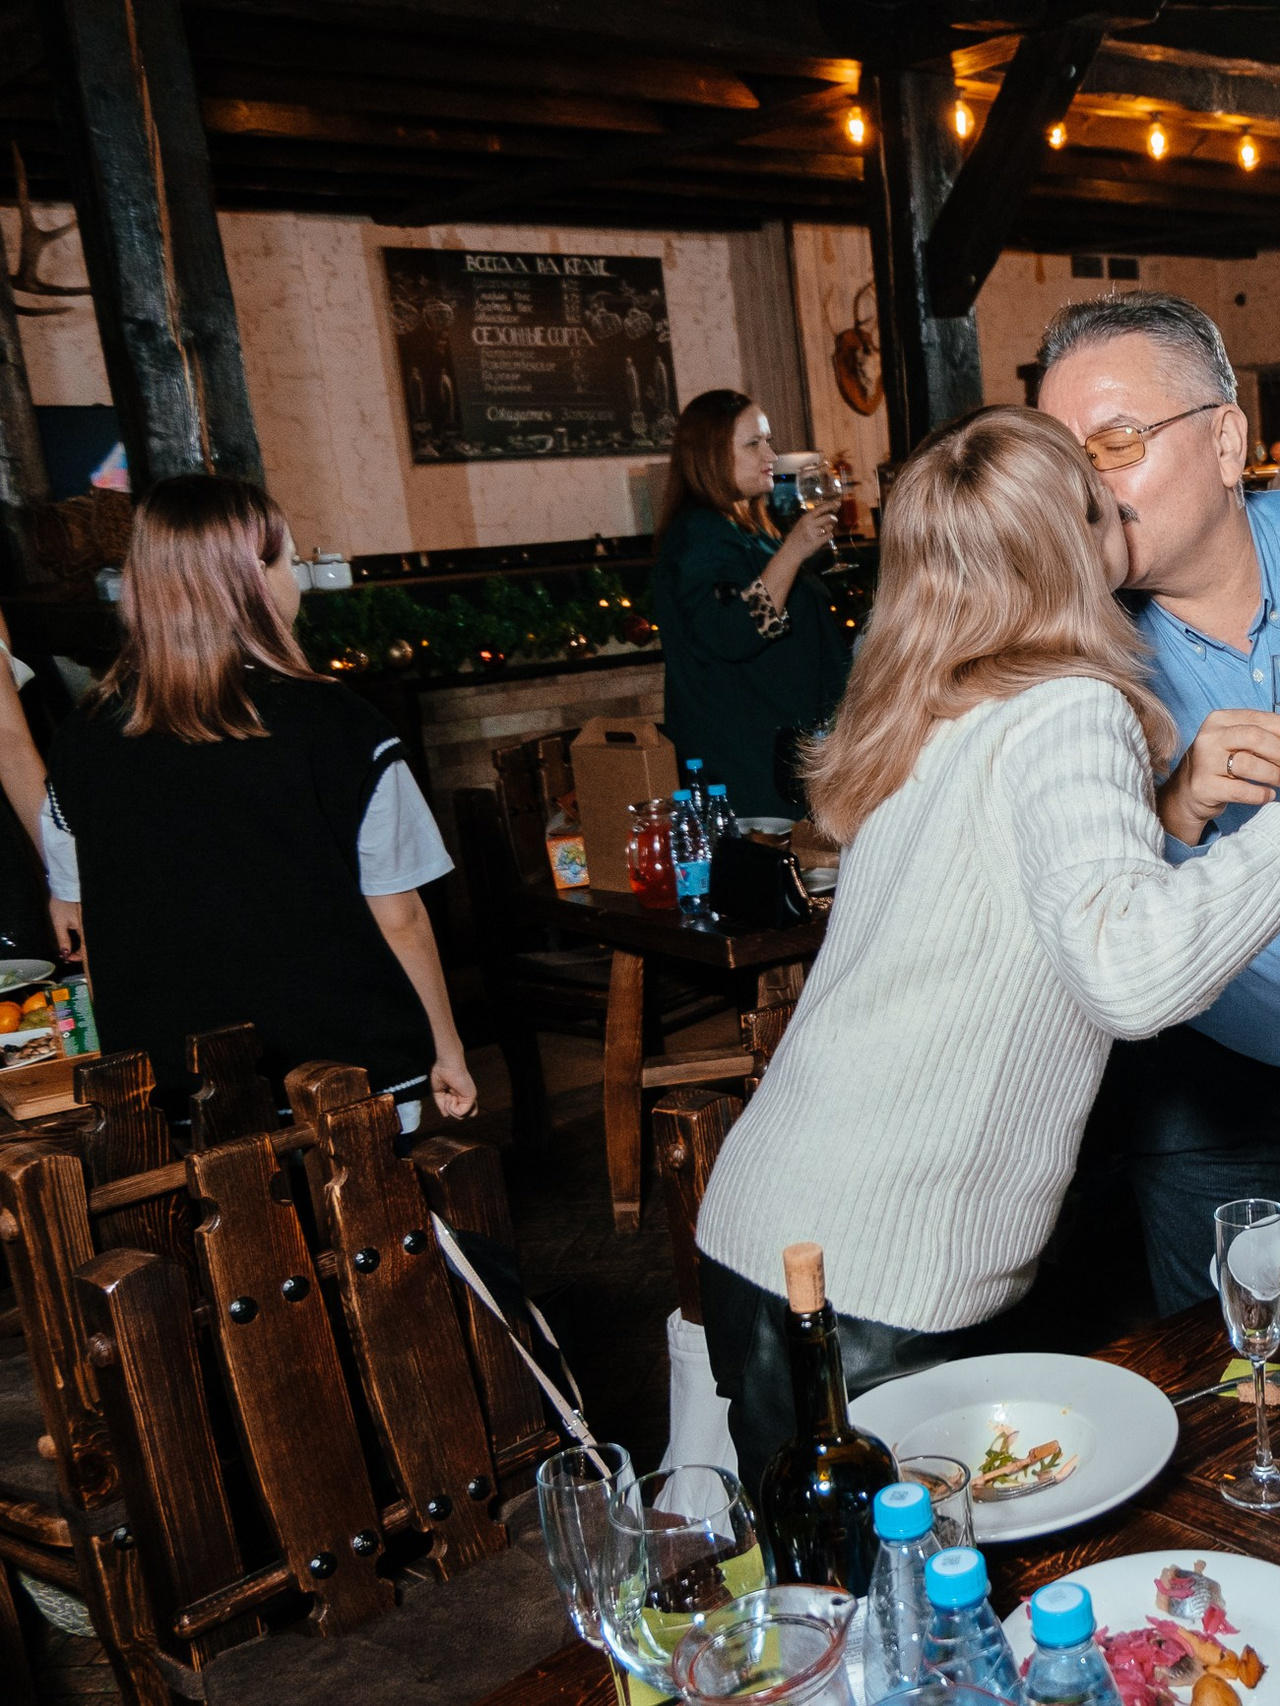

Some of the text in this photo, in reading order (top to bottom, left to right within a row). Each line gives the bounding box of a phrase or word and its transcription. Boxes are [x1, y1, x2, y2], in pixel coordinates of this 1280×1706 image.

[466, 255, 529, 272] ВСЕГДА
[535, 257, 561, 275] НА
[472, 326, 595, 346] СЕЗОННЫЕ СОРТА
